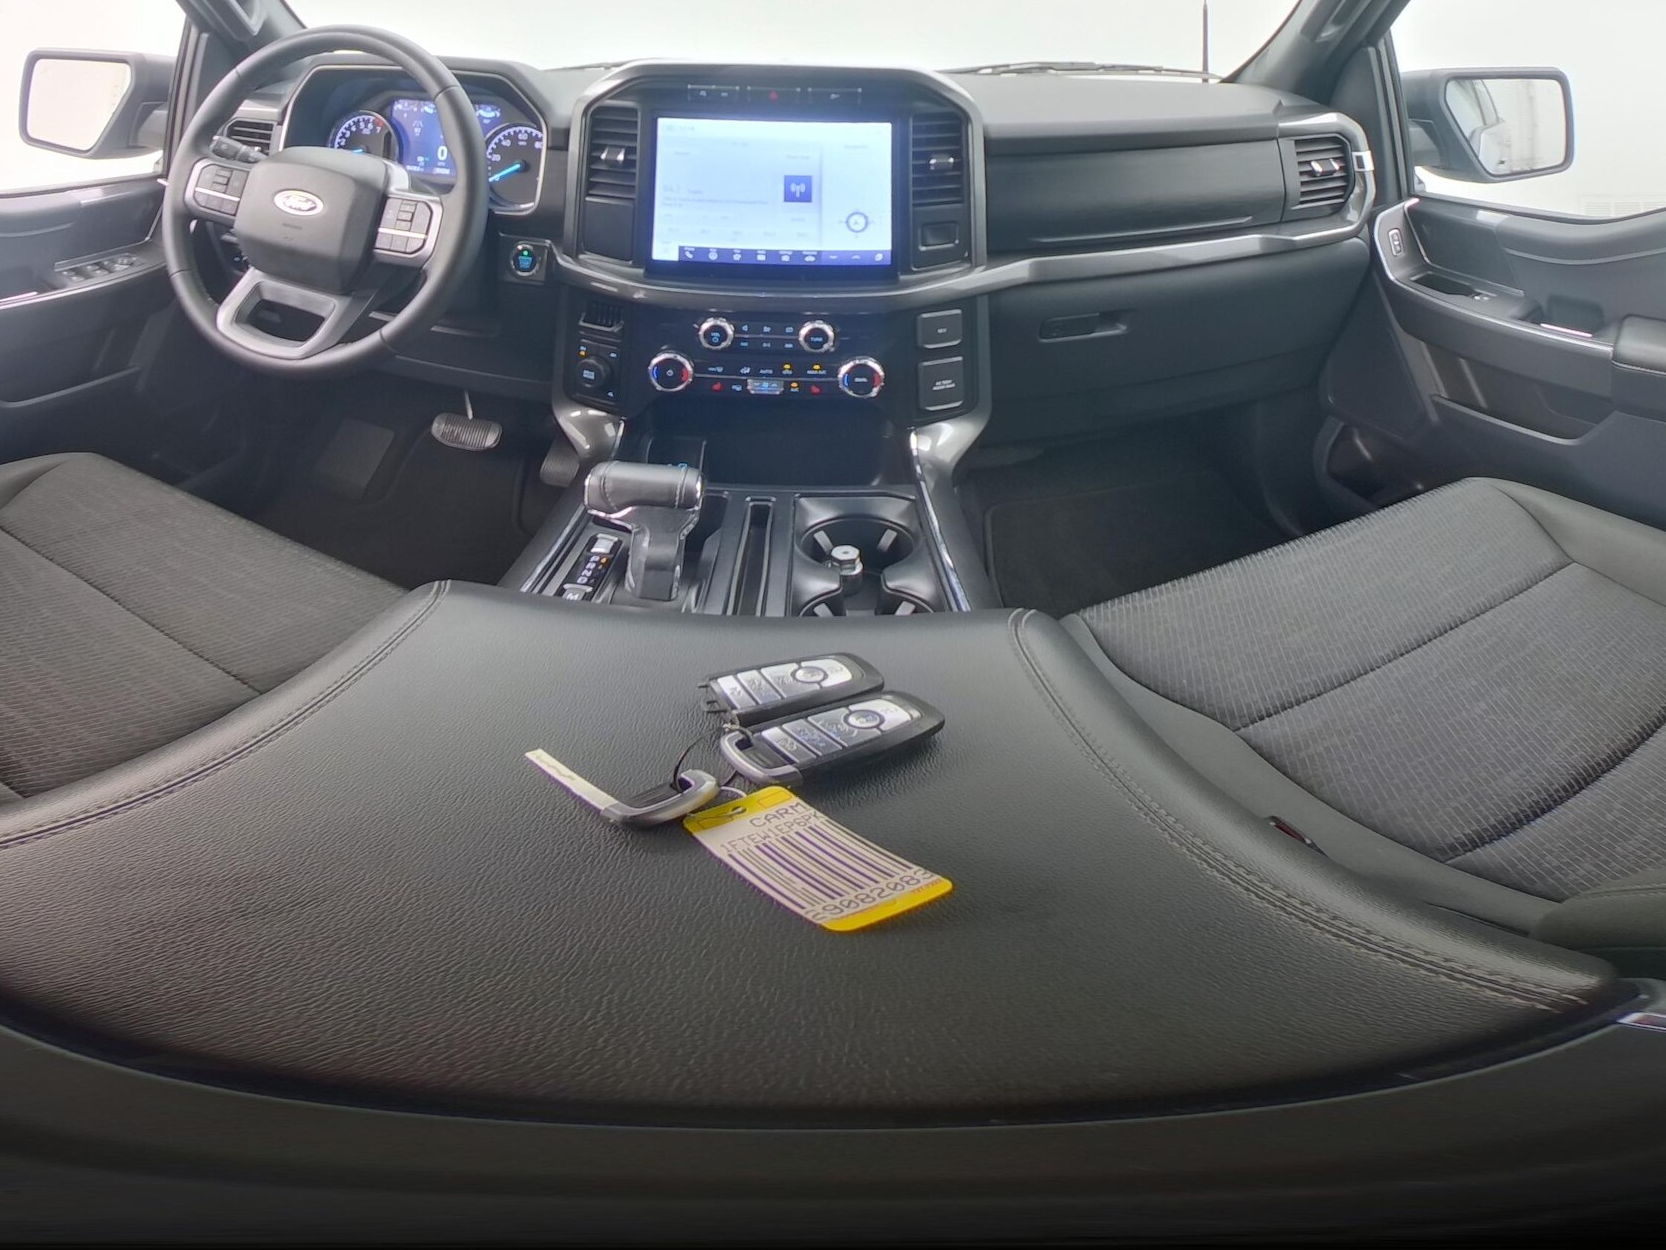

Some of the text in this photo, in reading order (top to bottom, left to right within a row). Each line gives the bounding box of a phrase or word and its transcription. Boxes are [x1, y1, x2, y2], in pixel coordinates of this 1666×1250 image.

[367, 122, 374, 130] 6
[437, 145, 448, 161] 0
[581, 569, 592, 577] N
[577, 576, 588, 584] D
